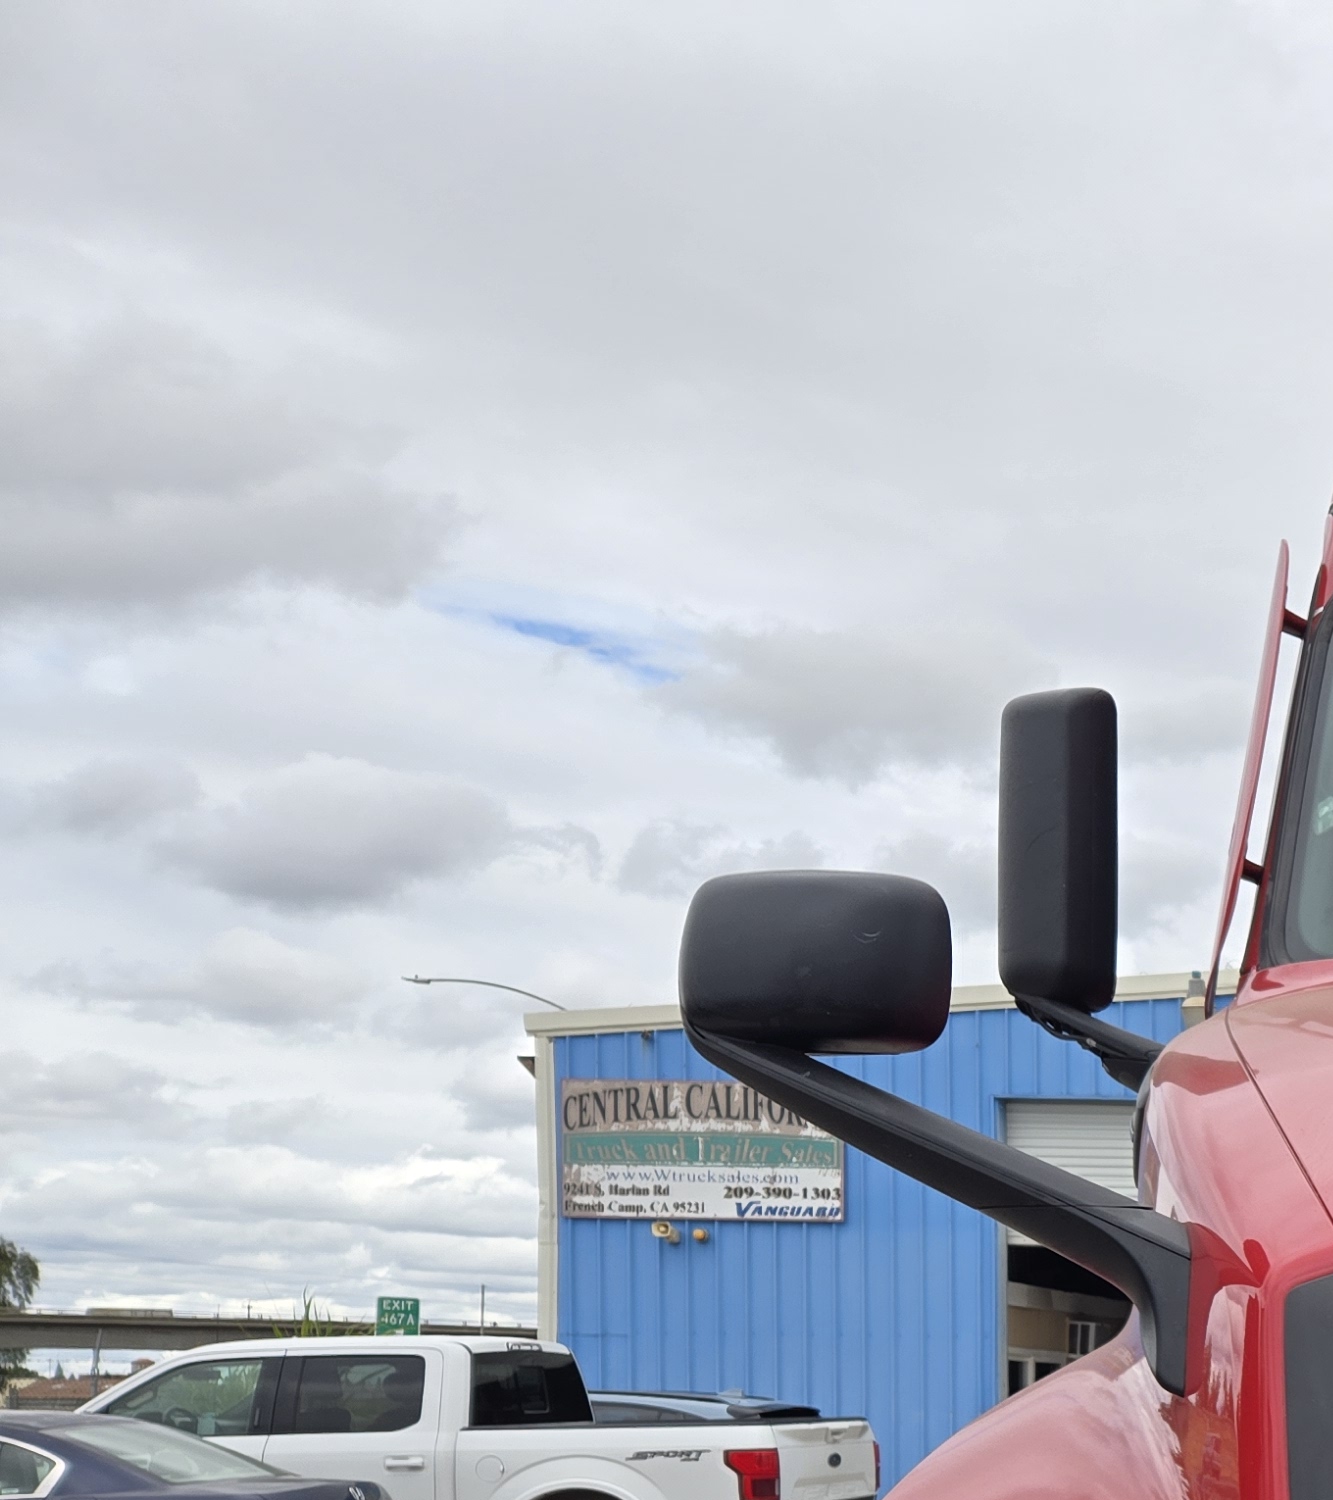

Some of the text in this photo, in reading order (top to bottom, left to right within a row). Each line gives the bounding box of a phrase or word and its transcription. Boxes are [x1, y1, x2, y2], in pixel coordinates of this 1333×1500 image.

[563, 1084, 679, 1131] CENTRAL
[574, 1136, 832, 1163] Truck and Trailer Sales
[608, 1184, 650, 1196] Harlan
[653, 1184, 670, 1196] Rd
[723, 1186, 841, 1200] 209-390-1303
[564, 1200, 605, 1213] French
[649, 1201, 669, 1213] CA
[673, 1201, 705, 1214] 95231
[735, 1200, 841, 1217] VANGUARD
[382, 1299, 415, 1311] EXIT
